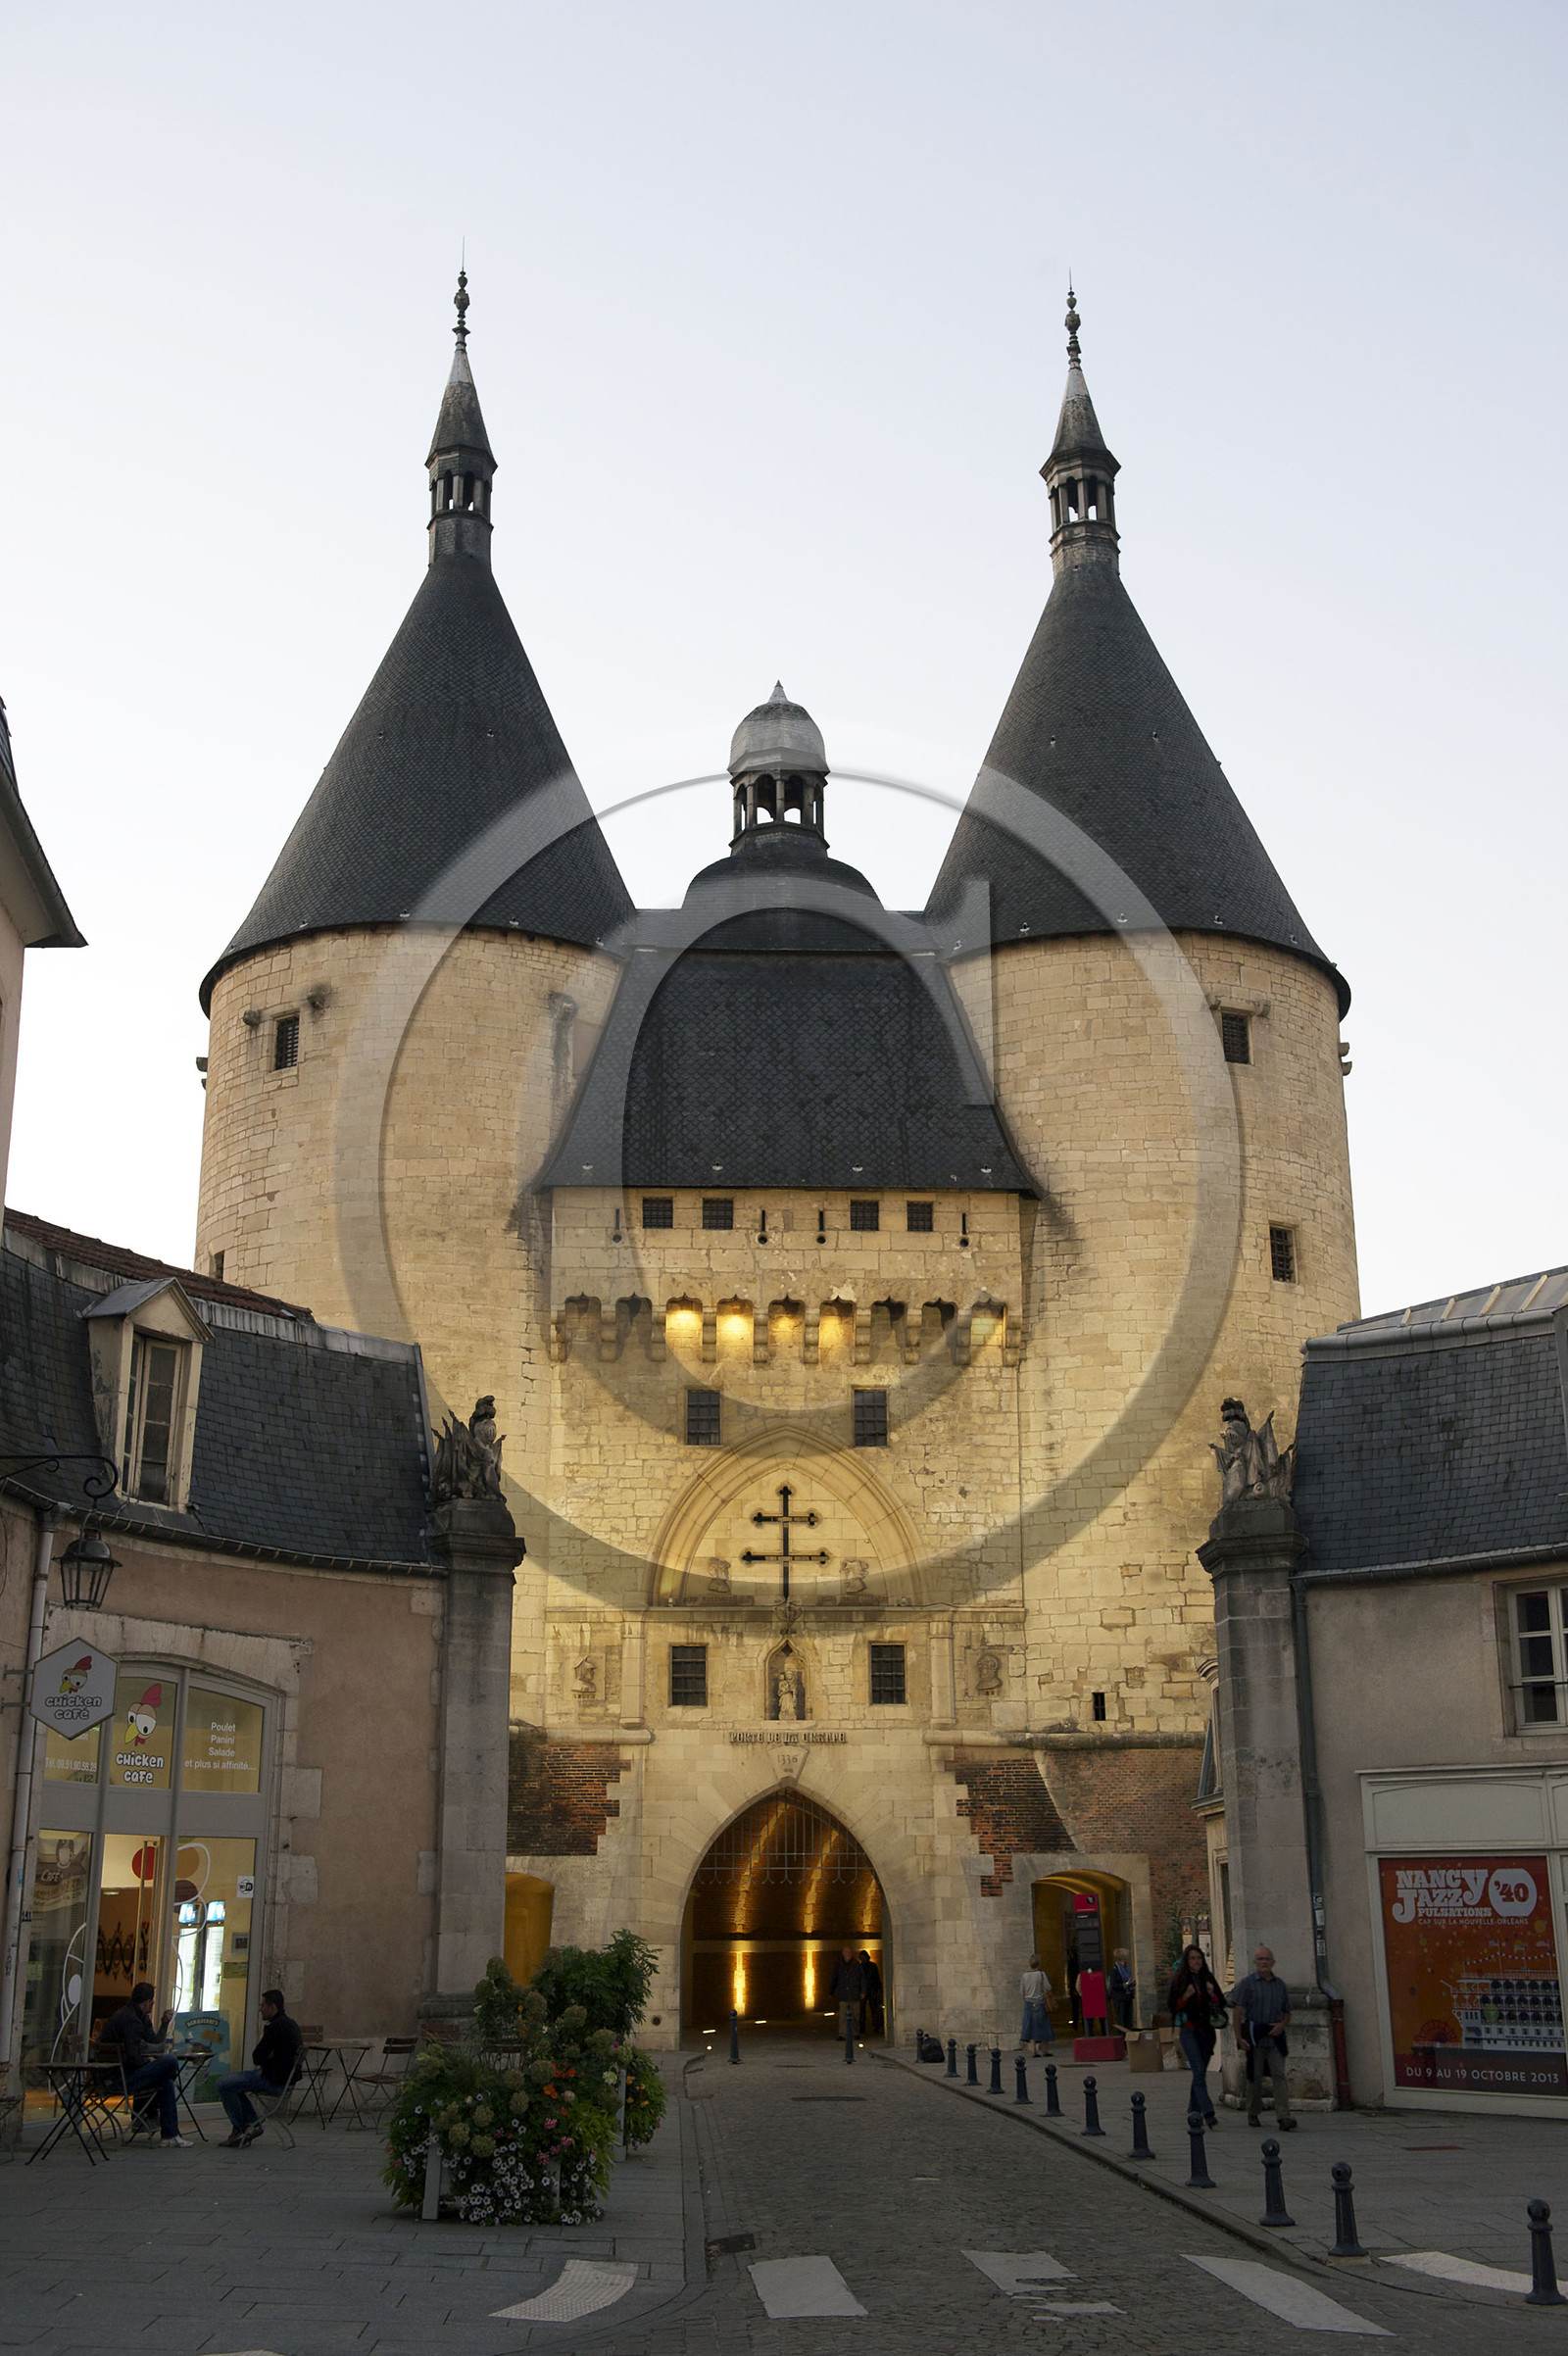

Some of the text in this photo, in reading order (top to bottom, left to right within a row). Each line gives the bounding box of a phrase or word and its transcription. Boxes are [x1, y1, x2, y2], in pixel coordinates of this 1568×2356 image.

[211, 1722, 236, 1732] Poulet
[210, 1735, 235, 1744] Panini
[730, 1731, 764, 1743] PORTE
[766, 1731, 782, 1743] DE
[208, 1747, 235, 1757] Salade
[194, 1760, 212, 1769] plus
[213, 1760, 220, 1769] si
[1396, 1869, 1489, 1906] NANCY
[1392, 1889, 1464, 1924] JAZZ
[1417, 1907, 1493, 1918] PULSATIONS
[1405, 2067, 1559, 2084] DU 9 AU 19 OCTOBRE 2013
